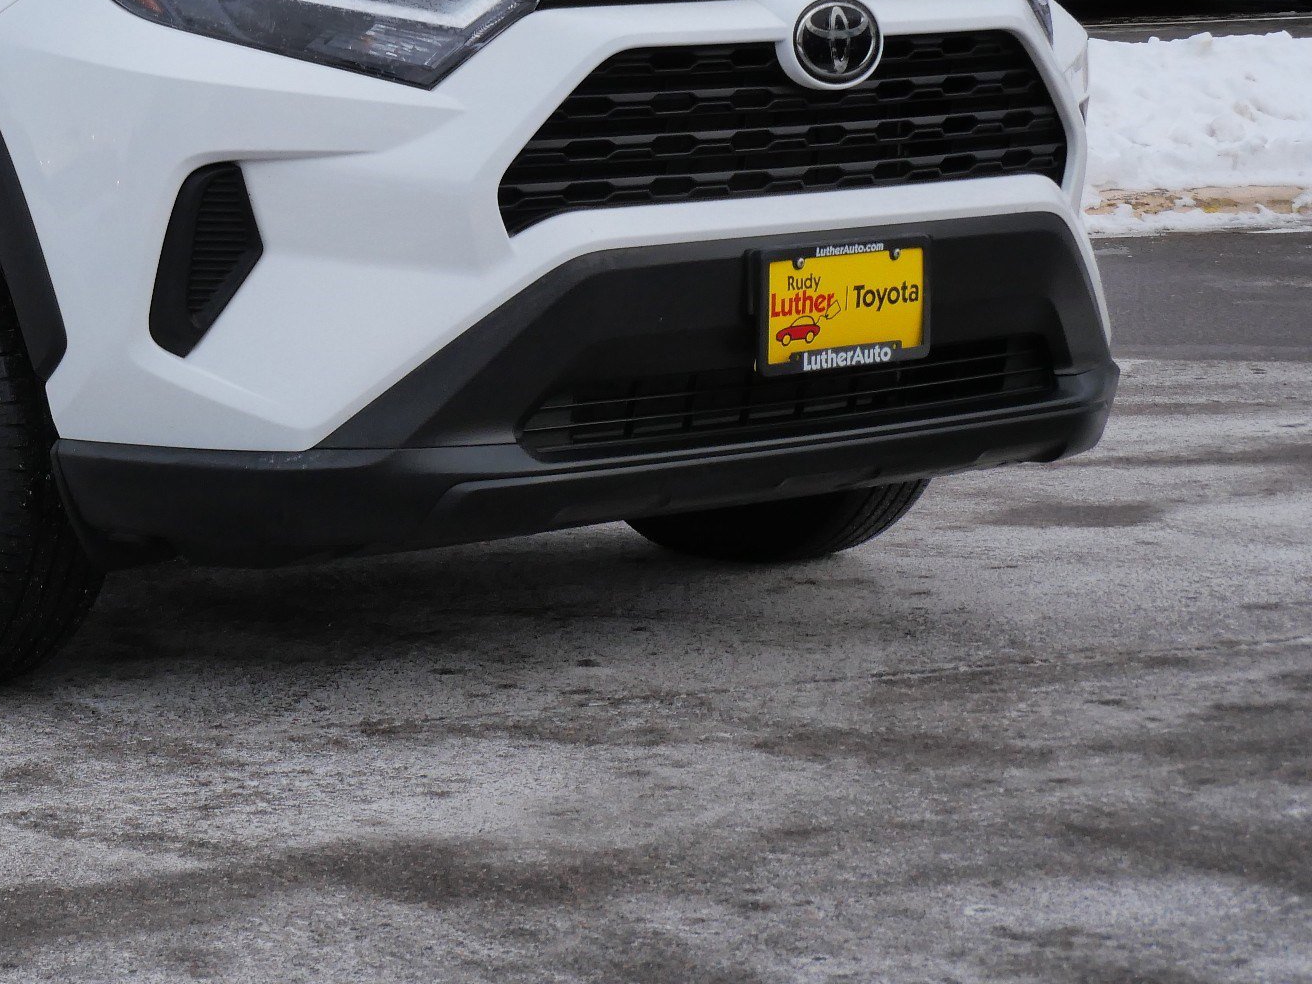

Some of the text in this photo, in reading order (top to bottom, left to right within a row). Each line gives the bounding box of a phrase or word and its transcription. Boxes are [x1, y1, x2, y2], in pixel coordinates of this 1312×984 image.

[815, 242, 884, 258] LutherAuto.com
[787, 273, 821, 292] Rudy
[770, 280, 919, 318] Luther Toyota
[803, 345, 892, 371] LutherAuto
